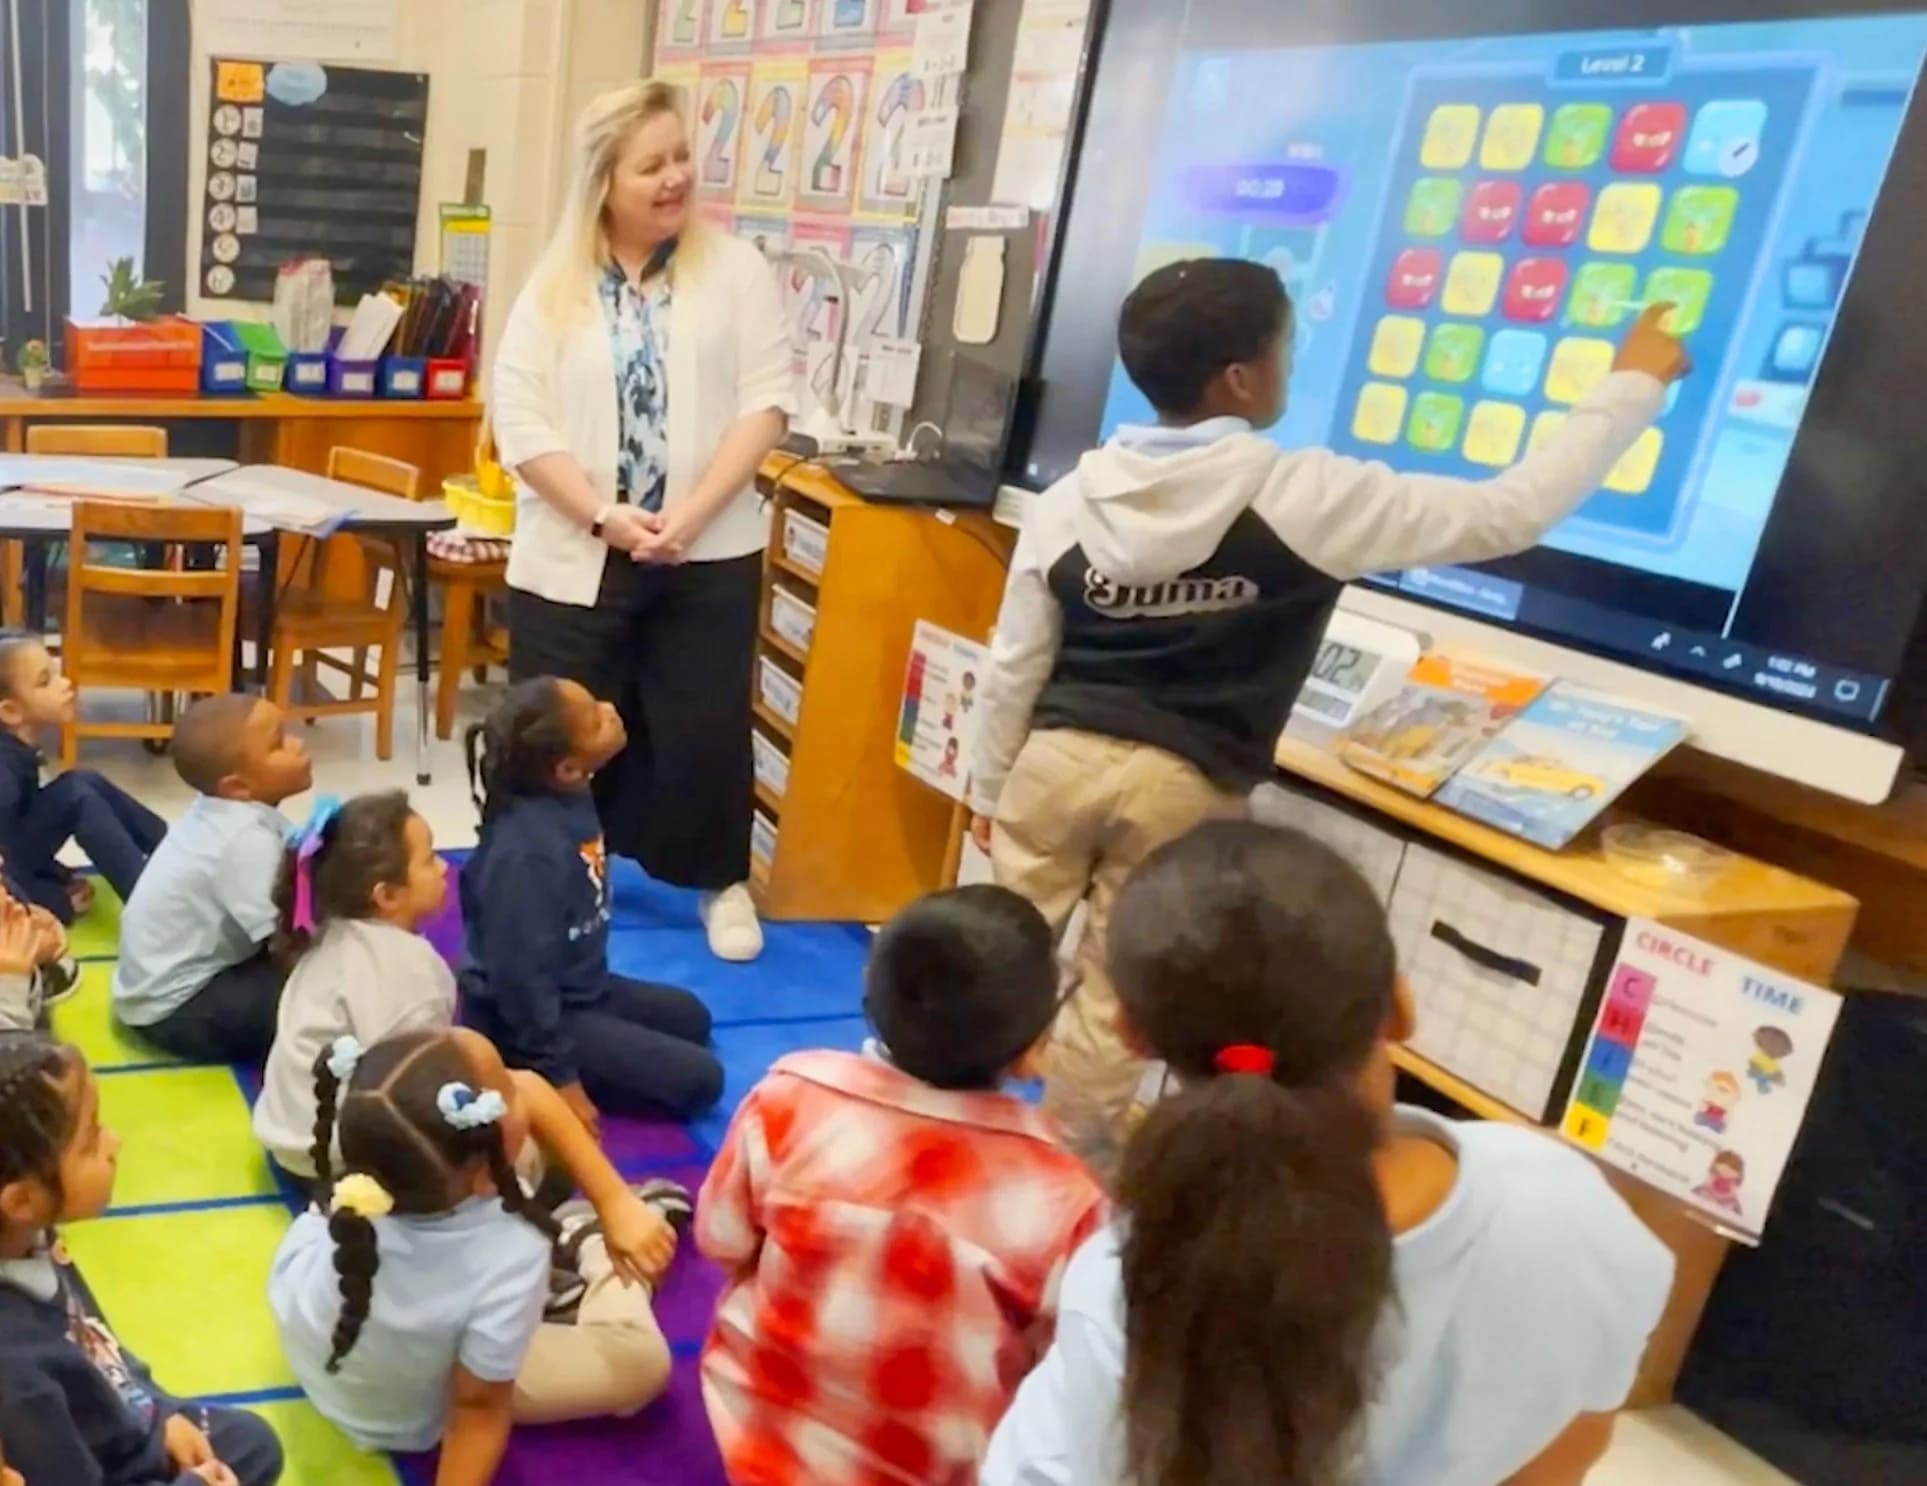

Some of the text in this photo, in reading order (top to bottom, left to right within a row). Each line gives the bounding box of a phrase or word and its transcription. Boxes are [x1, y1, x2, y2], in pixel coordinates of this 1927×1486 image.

[1630, 53, 1646, 73] 2
[702, 78, 739, 183] 2
[754, 85, 792, 196] 2
[810, 74, 854, 193] 2
[1623, 976, 1640, 999] C
[1637, 931, 1715, 977] CIRCLE
[1742, 975, 1804, 1015] TIME
[1609, 1008, 1632, 1035] H
